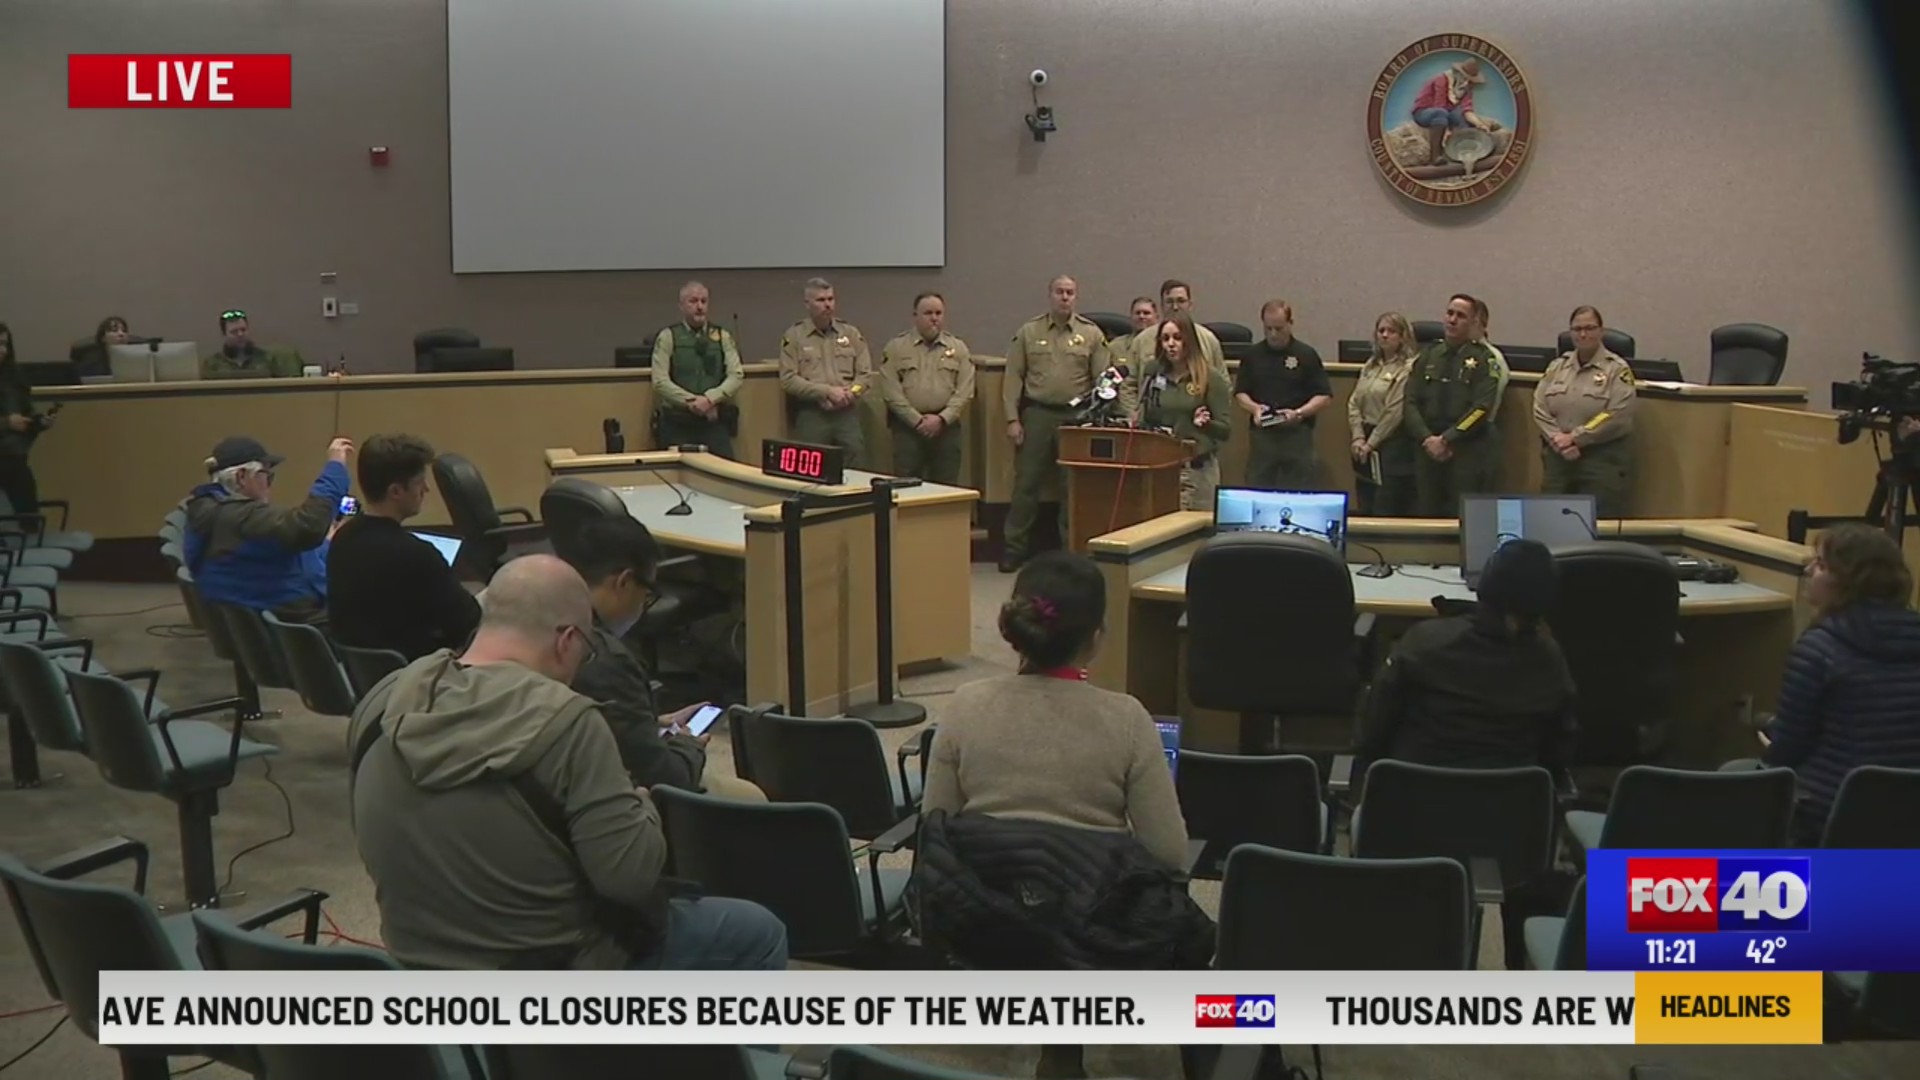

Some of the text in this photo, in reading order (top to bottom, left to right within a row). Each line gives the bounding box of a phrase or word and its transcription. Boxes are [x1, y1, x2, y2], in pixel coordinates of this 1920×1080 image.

[1373, 35, 1526, 100] BOARD OF SUPERVISORS
[1371, 138, 1406, 188] COUNTY
